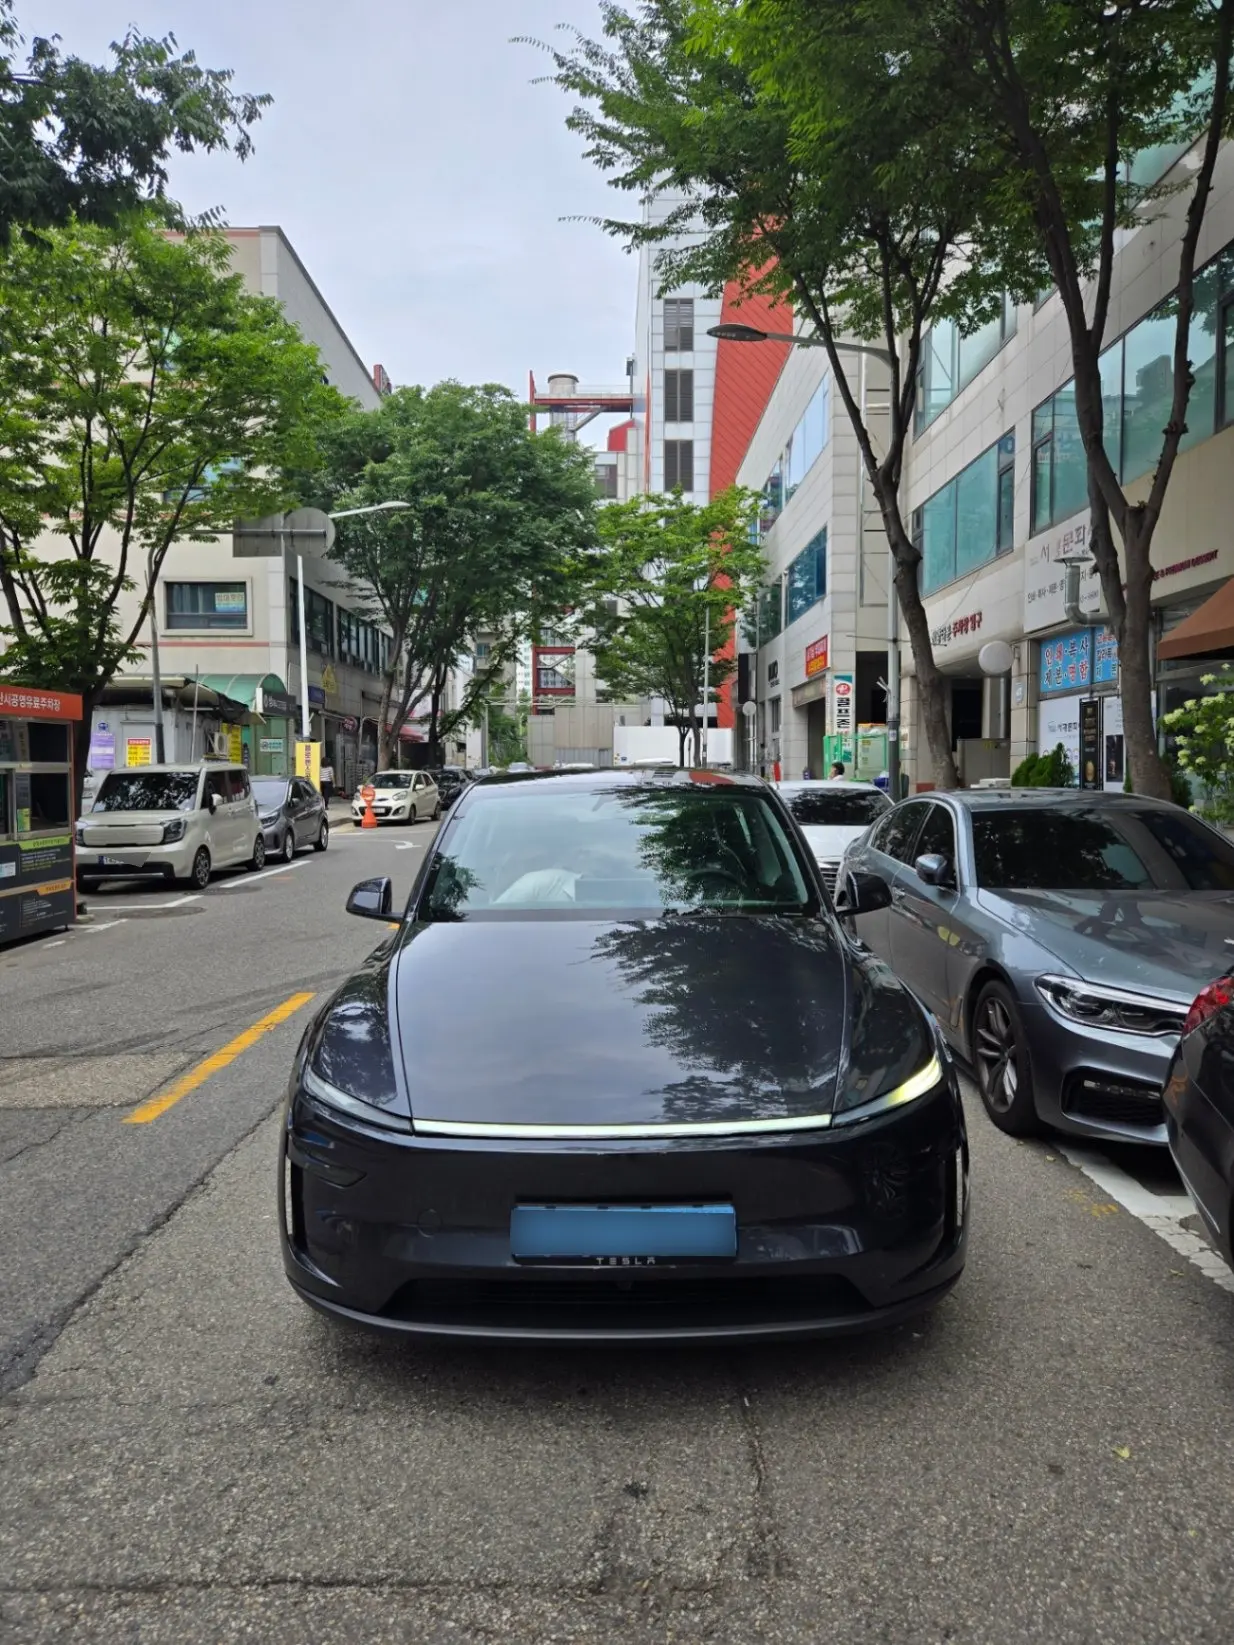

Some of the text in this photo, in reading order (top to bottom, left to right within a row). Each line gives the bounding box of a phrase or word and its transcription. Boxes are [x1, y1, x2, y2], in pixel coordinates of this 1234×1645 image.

[1041, 524, 1092, 562] 서문화
[836, 697, 851, 729] 골프존
[596, 1256, 656, 1265] TESLA
